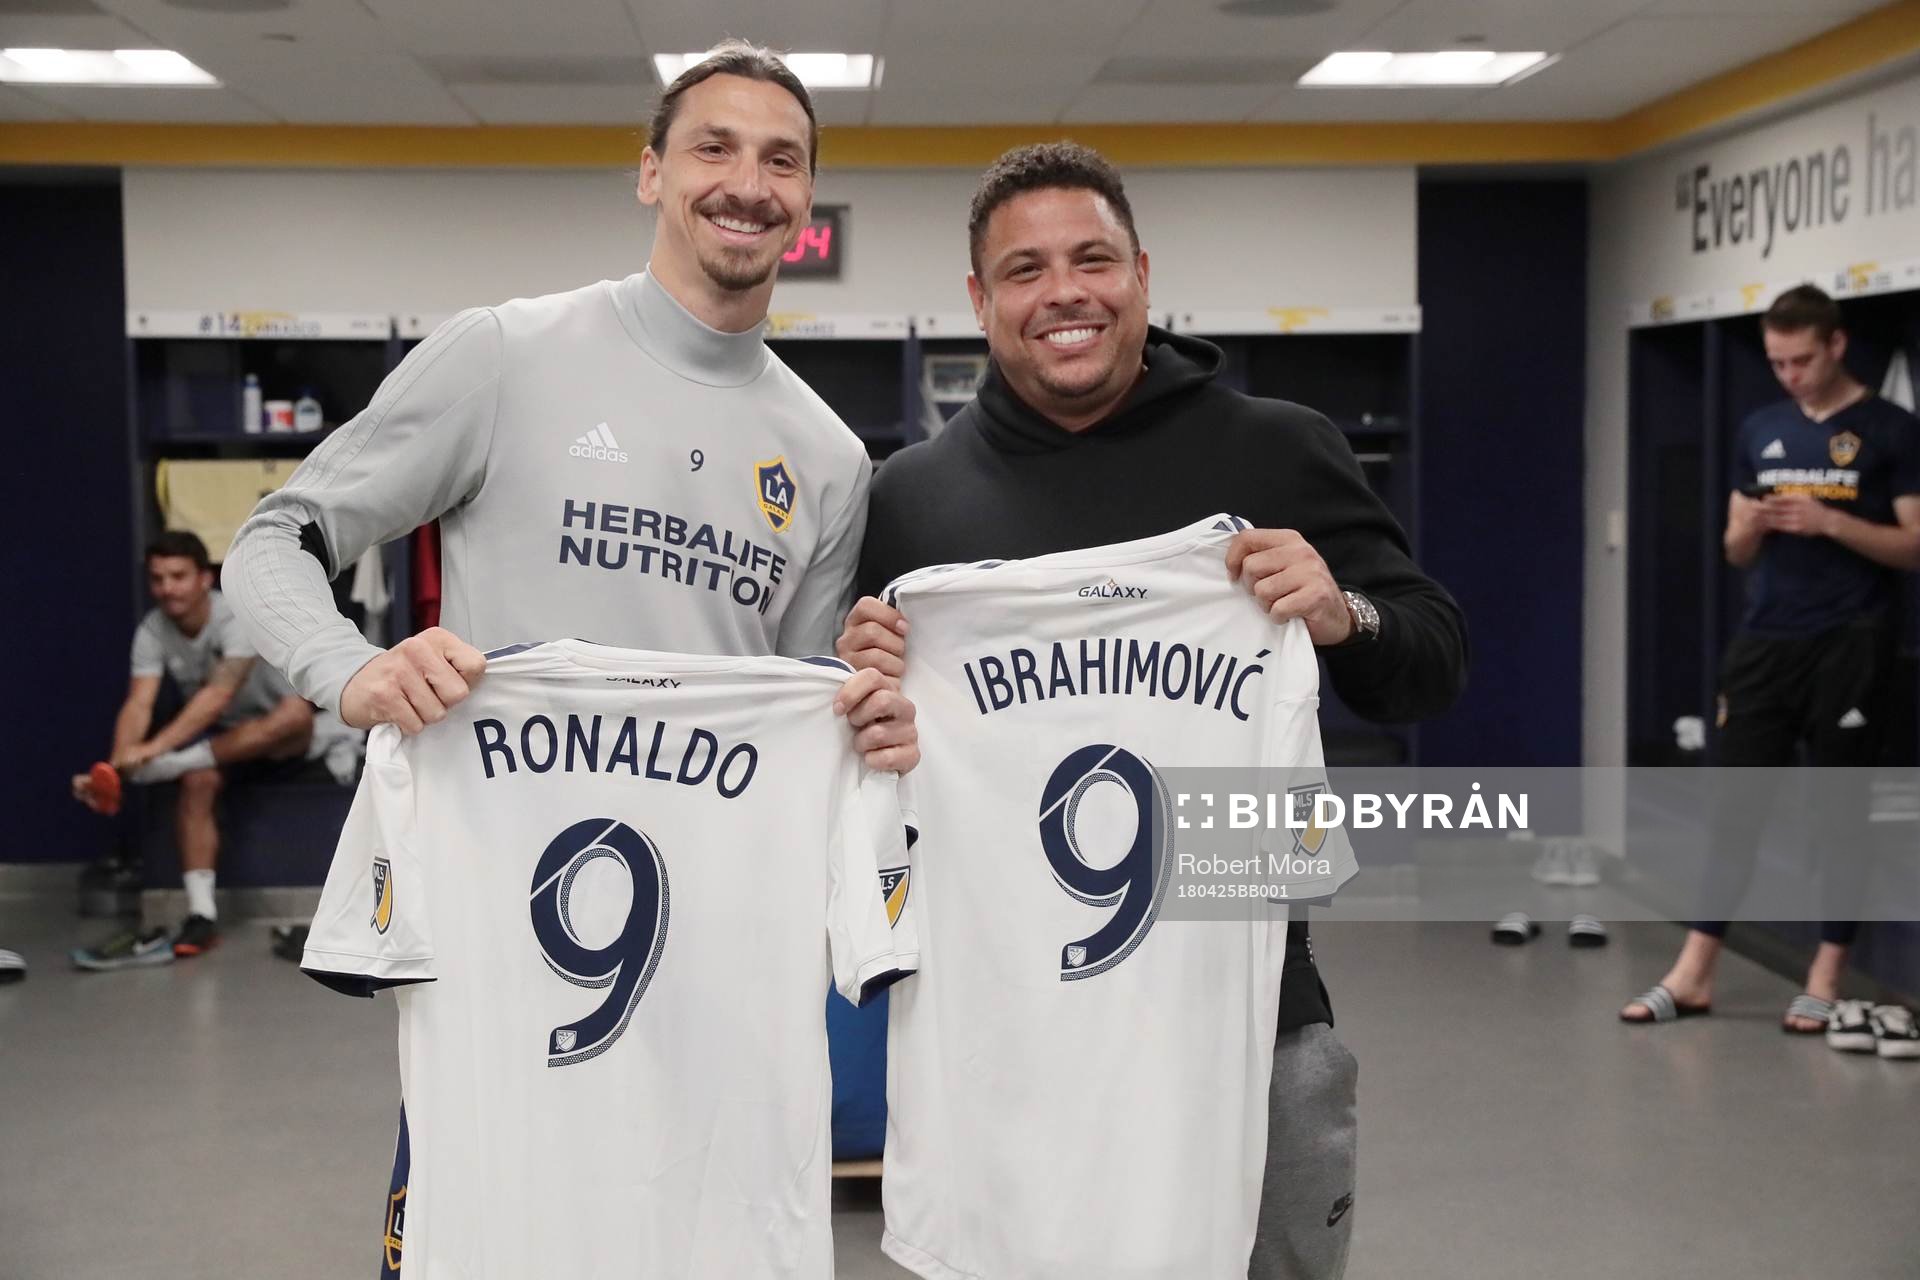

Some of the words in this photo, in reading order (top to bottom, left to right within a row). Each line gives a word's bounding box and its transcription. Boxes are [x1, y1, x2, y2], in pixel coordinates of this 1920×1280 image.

[568, 444, 629, 463] adidas
[690, 448, 705, 472] 9
[765, 479, 789, 510] LA
[559, 534, 775, 616] NUTRITON
[562, 499, 787, 585] HERBALIFE
[1078, 585, 1148, 599] GALAXY
[963, 638, 1272, 722] IBRAHIMOVIĆ
[473, 714, 758, 799] RONALDO
[880, 876, 895, 890] LS
[1039, 743, 1175, 982] 9
[530, 818, 670, 1068] 9
